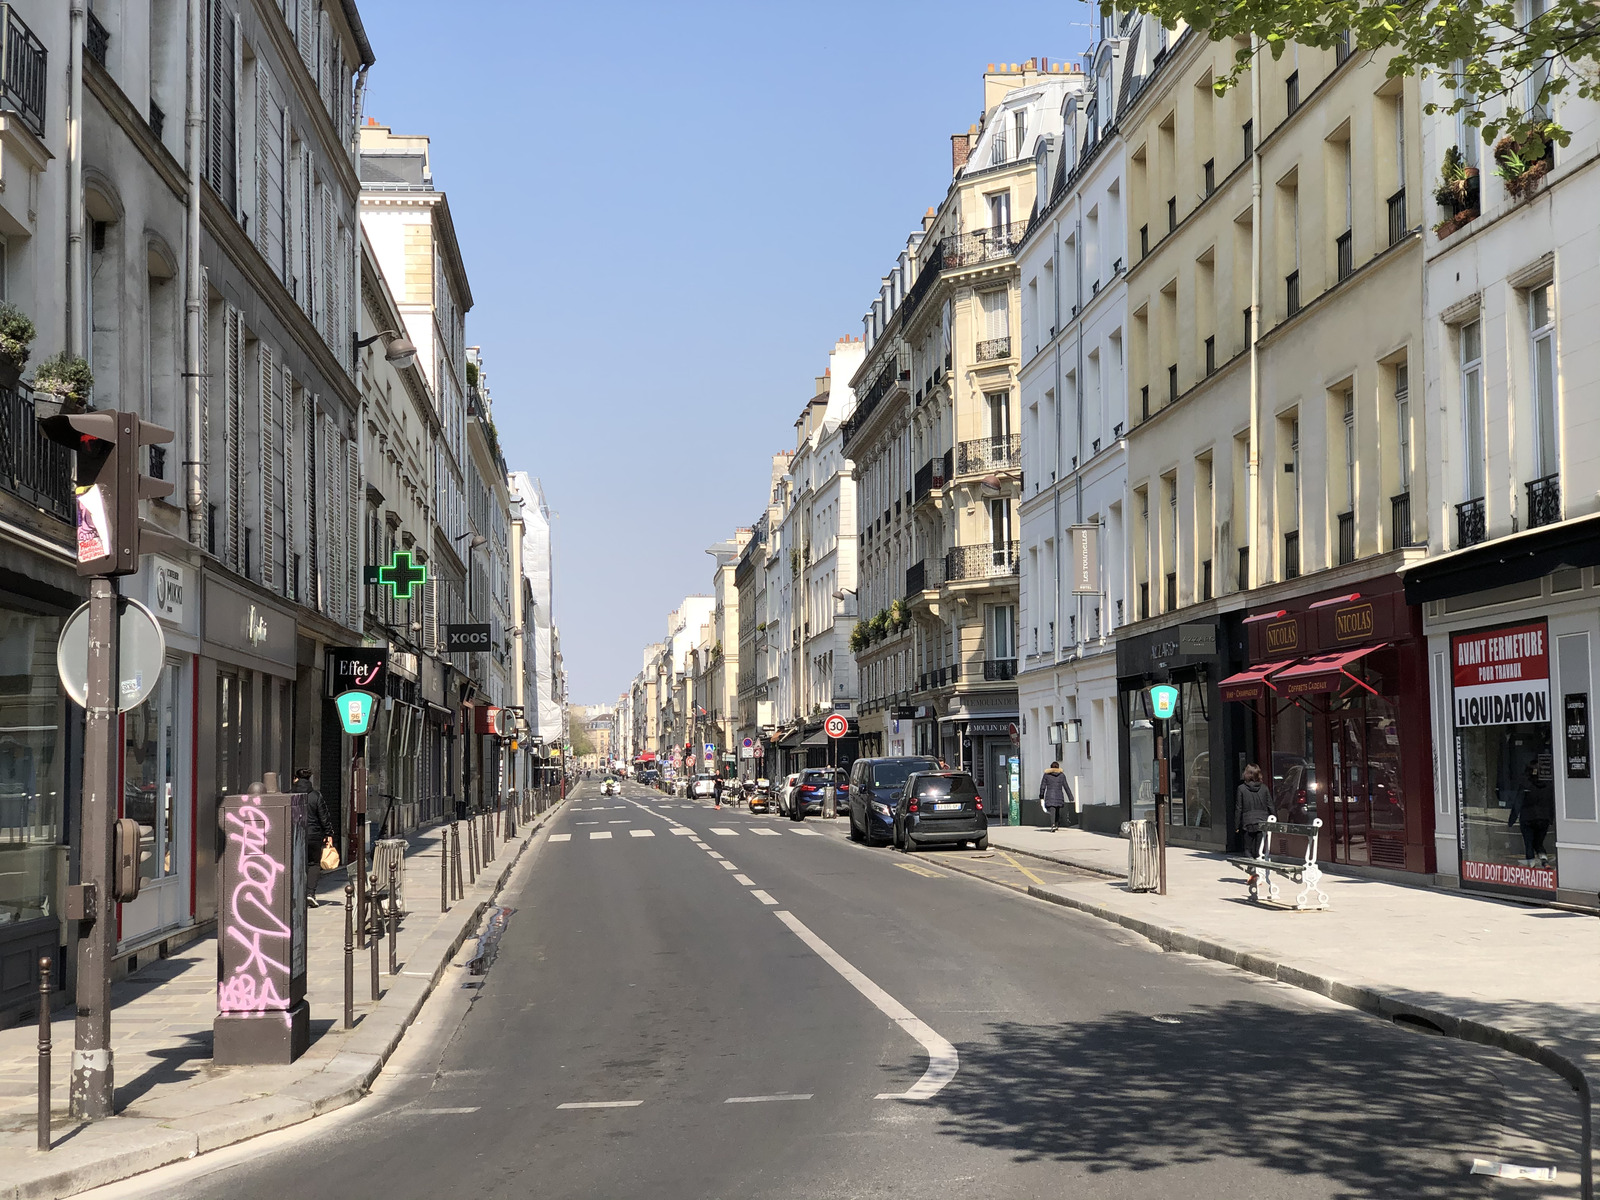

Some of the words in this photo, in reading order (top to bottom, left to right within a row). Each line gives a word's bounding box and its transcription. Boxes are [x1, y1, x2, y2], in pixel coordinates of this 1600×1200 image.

[1338, 611, 1370, 634] NICOLAS
[451, 633, 488, 644] XOOS
[1268, 626, 1296, 646] NICOLAS
[1458, 640, 1486, 666] AVANT
[1489, 630, 1543, 662] FERMETURE
[340, 660, 369, 676] Effet
[1479, 667, 1495, 681] POUR
[1495, 663, 1522, 679] TRAVAUX
[1458, 691, 1546, 726] LIQUIDATION
[830, 721, 844, 731] 30
[1466, 862, 1483, 879] TOUT
[1485, 864, 1502, 881] DOIT
[1503, 866, 1554, 889] DISPARAITRE
